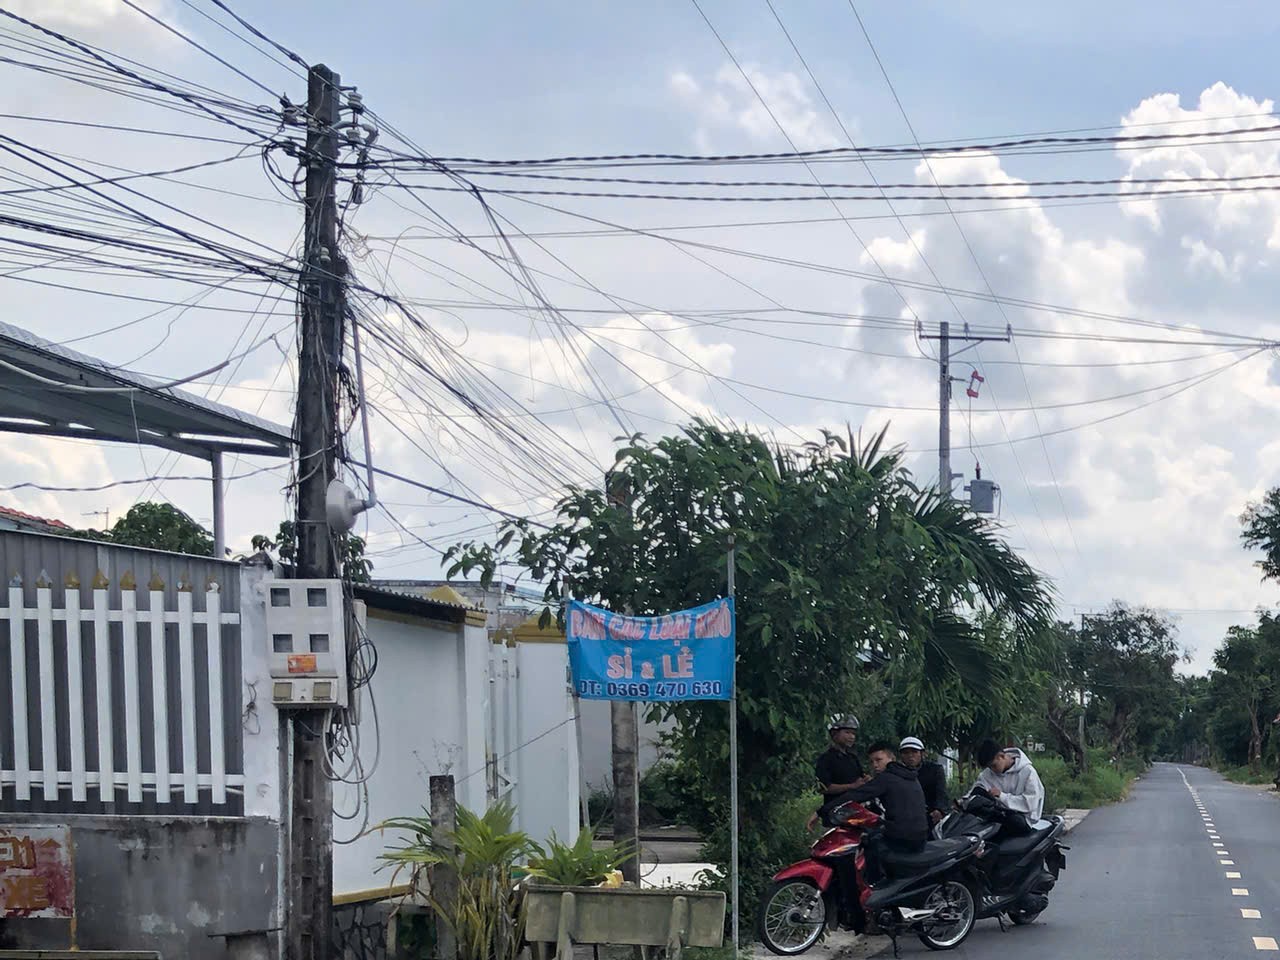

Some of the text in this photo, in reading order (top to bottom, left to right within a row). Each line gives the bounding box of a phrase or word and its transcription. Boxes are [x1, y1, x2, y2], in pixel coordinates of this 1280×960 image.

[640, 661, 655, 679] &
[607, 682, 649, 697] 0369
[655, 682, 687, 697] 470
[692, 681, 722, 696] 630
